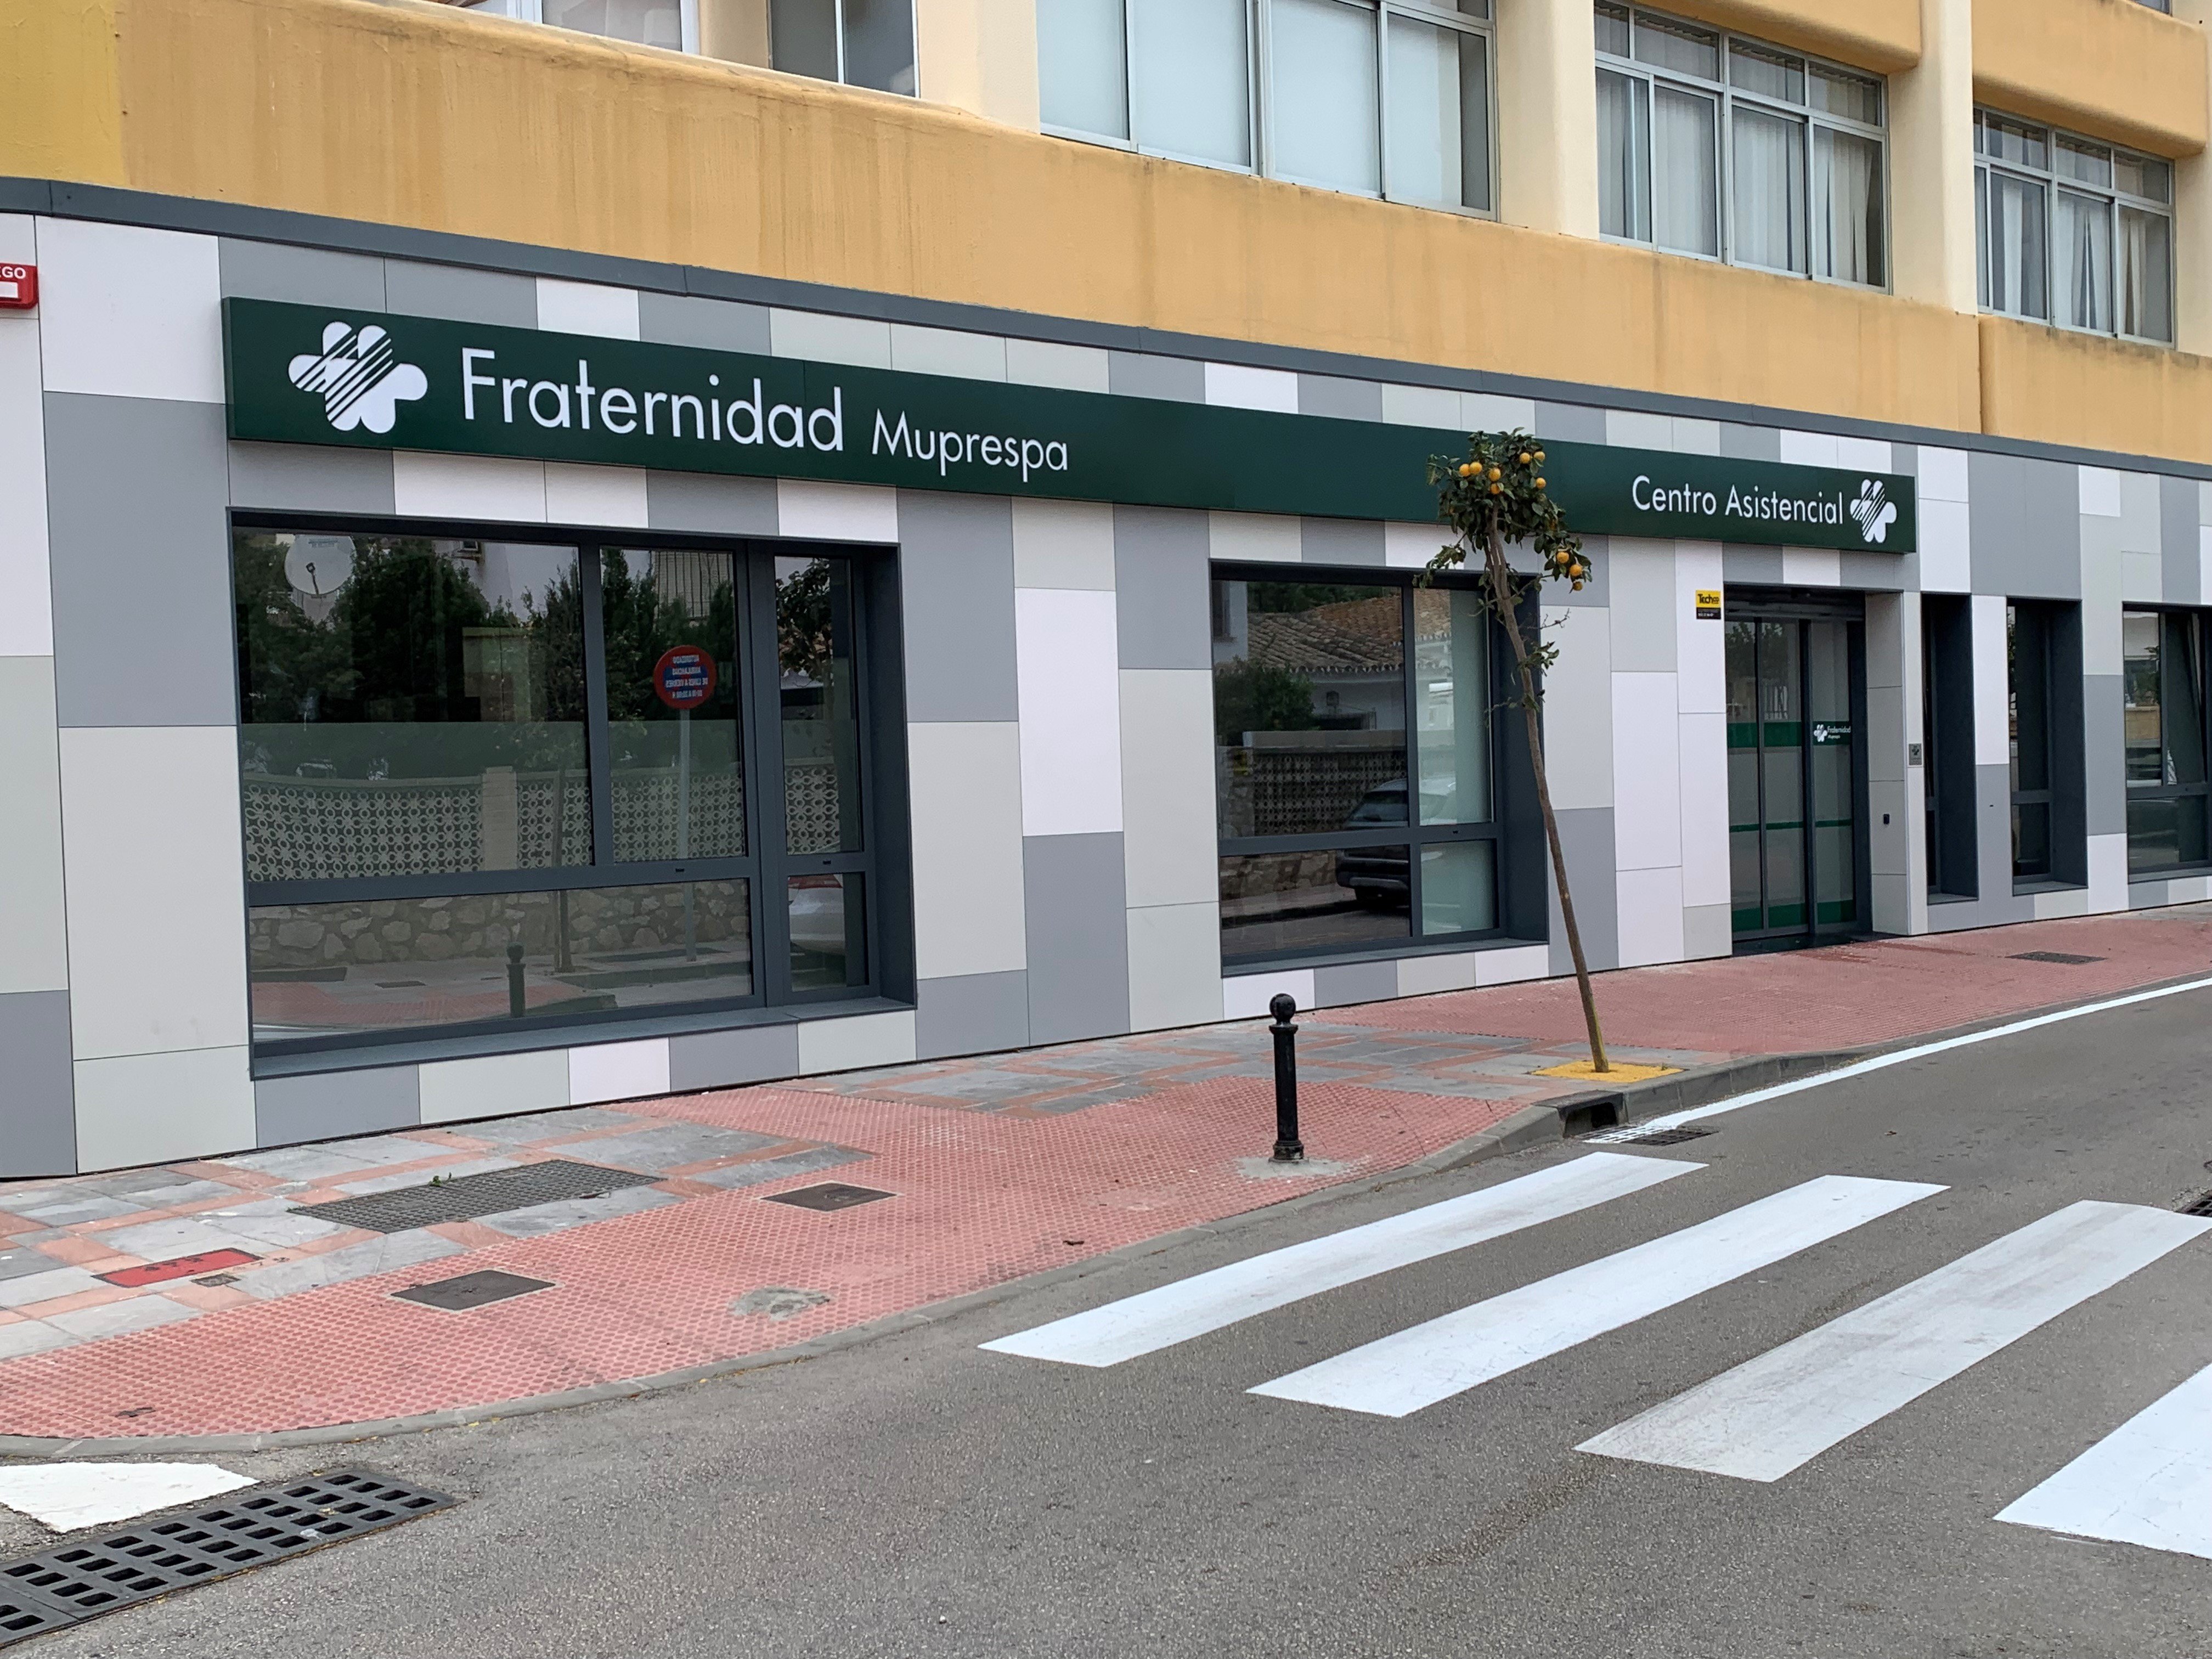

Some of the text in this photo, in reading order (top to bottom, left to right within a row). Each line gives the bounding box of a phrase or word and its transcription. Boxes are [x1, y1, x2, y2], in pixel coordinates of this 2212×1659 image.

[0, 264, 26, 279] GO
[461, 347, 1068, 483] Fraternidad Muprespa
[1632, 475, 1843, 524] Centro Asistencial
